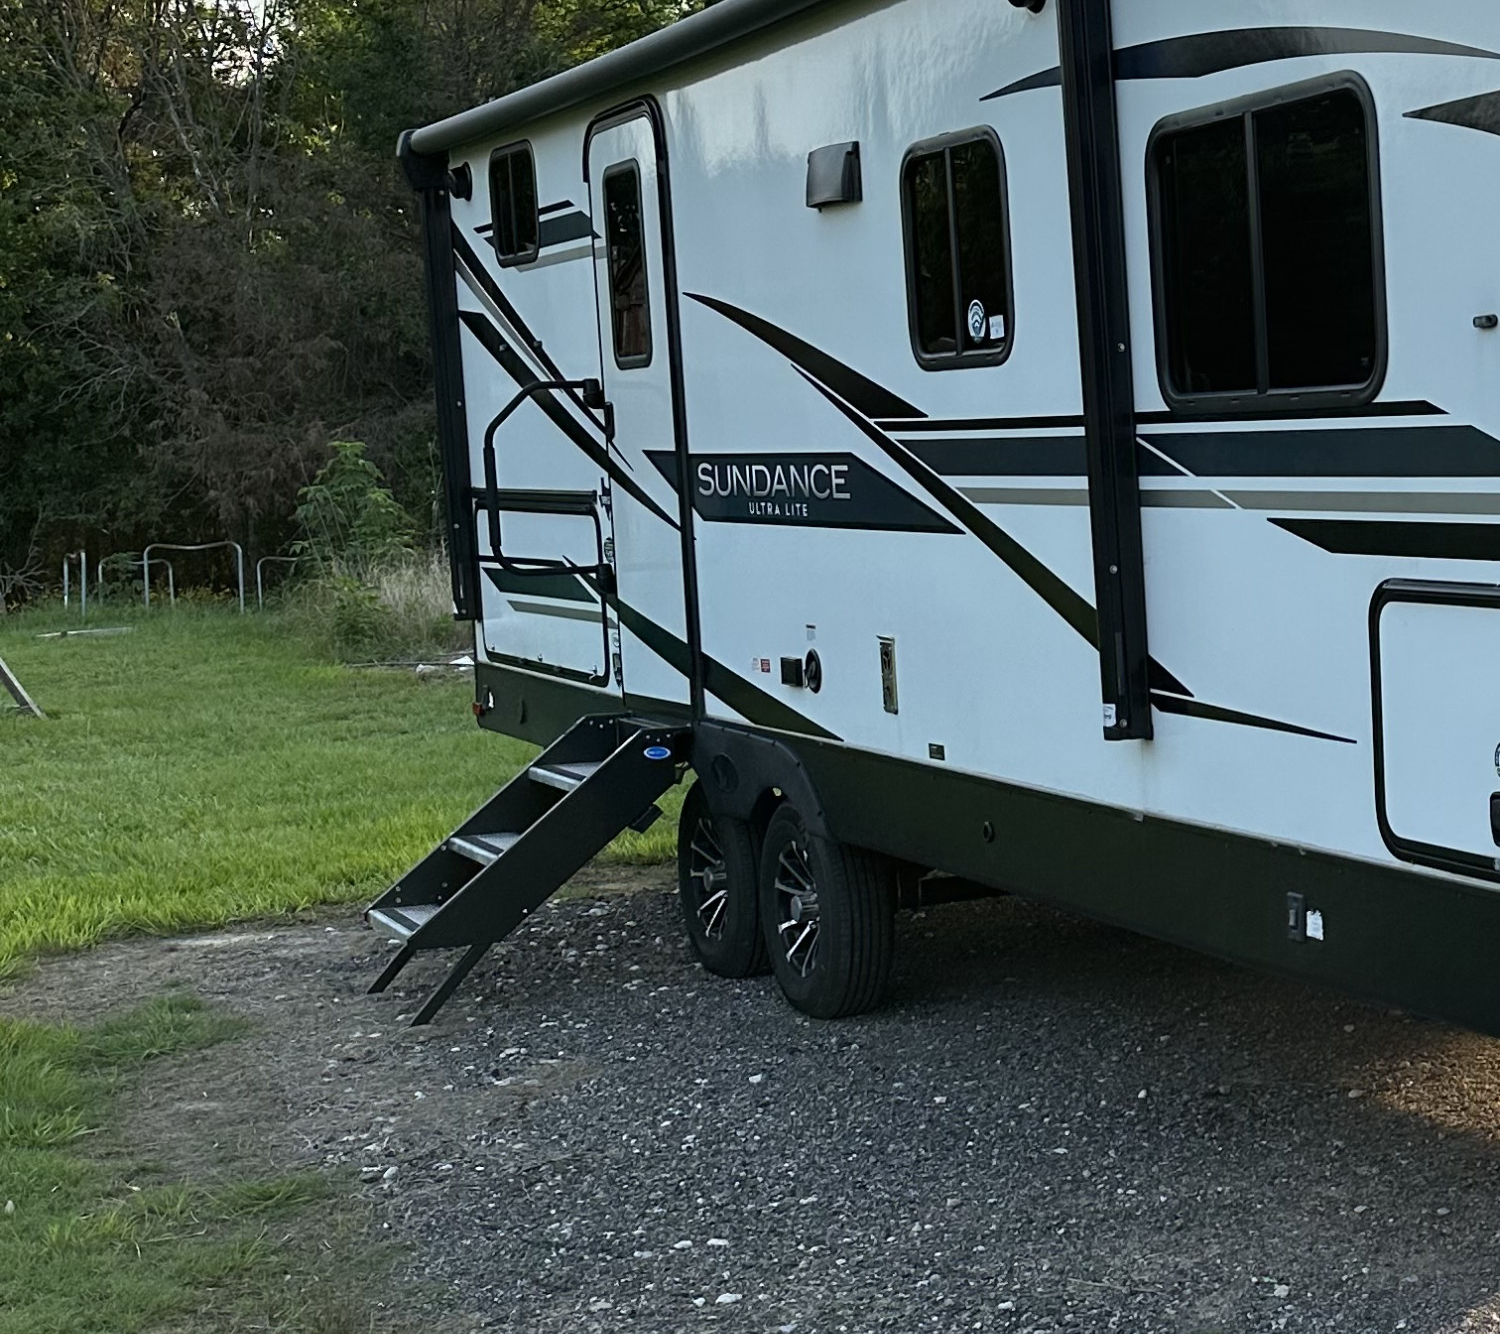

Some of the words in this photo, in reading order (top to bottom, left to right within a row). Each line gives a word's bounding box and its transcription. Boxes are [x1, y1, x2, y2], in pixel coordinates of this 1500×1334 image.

[697, 461, 851, 500] SUNDANCE
[748, 501, 781, 517] ULTRA
[785, 503, 809, 518] LITE
